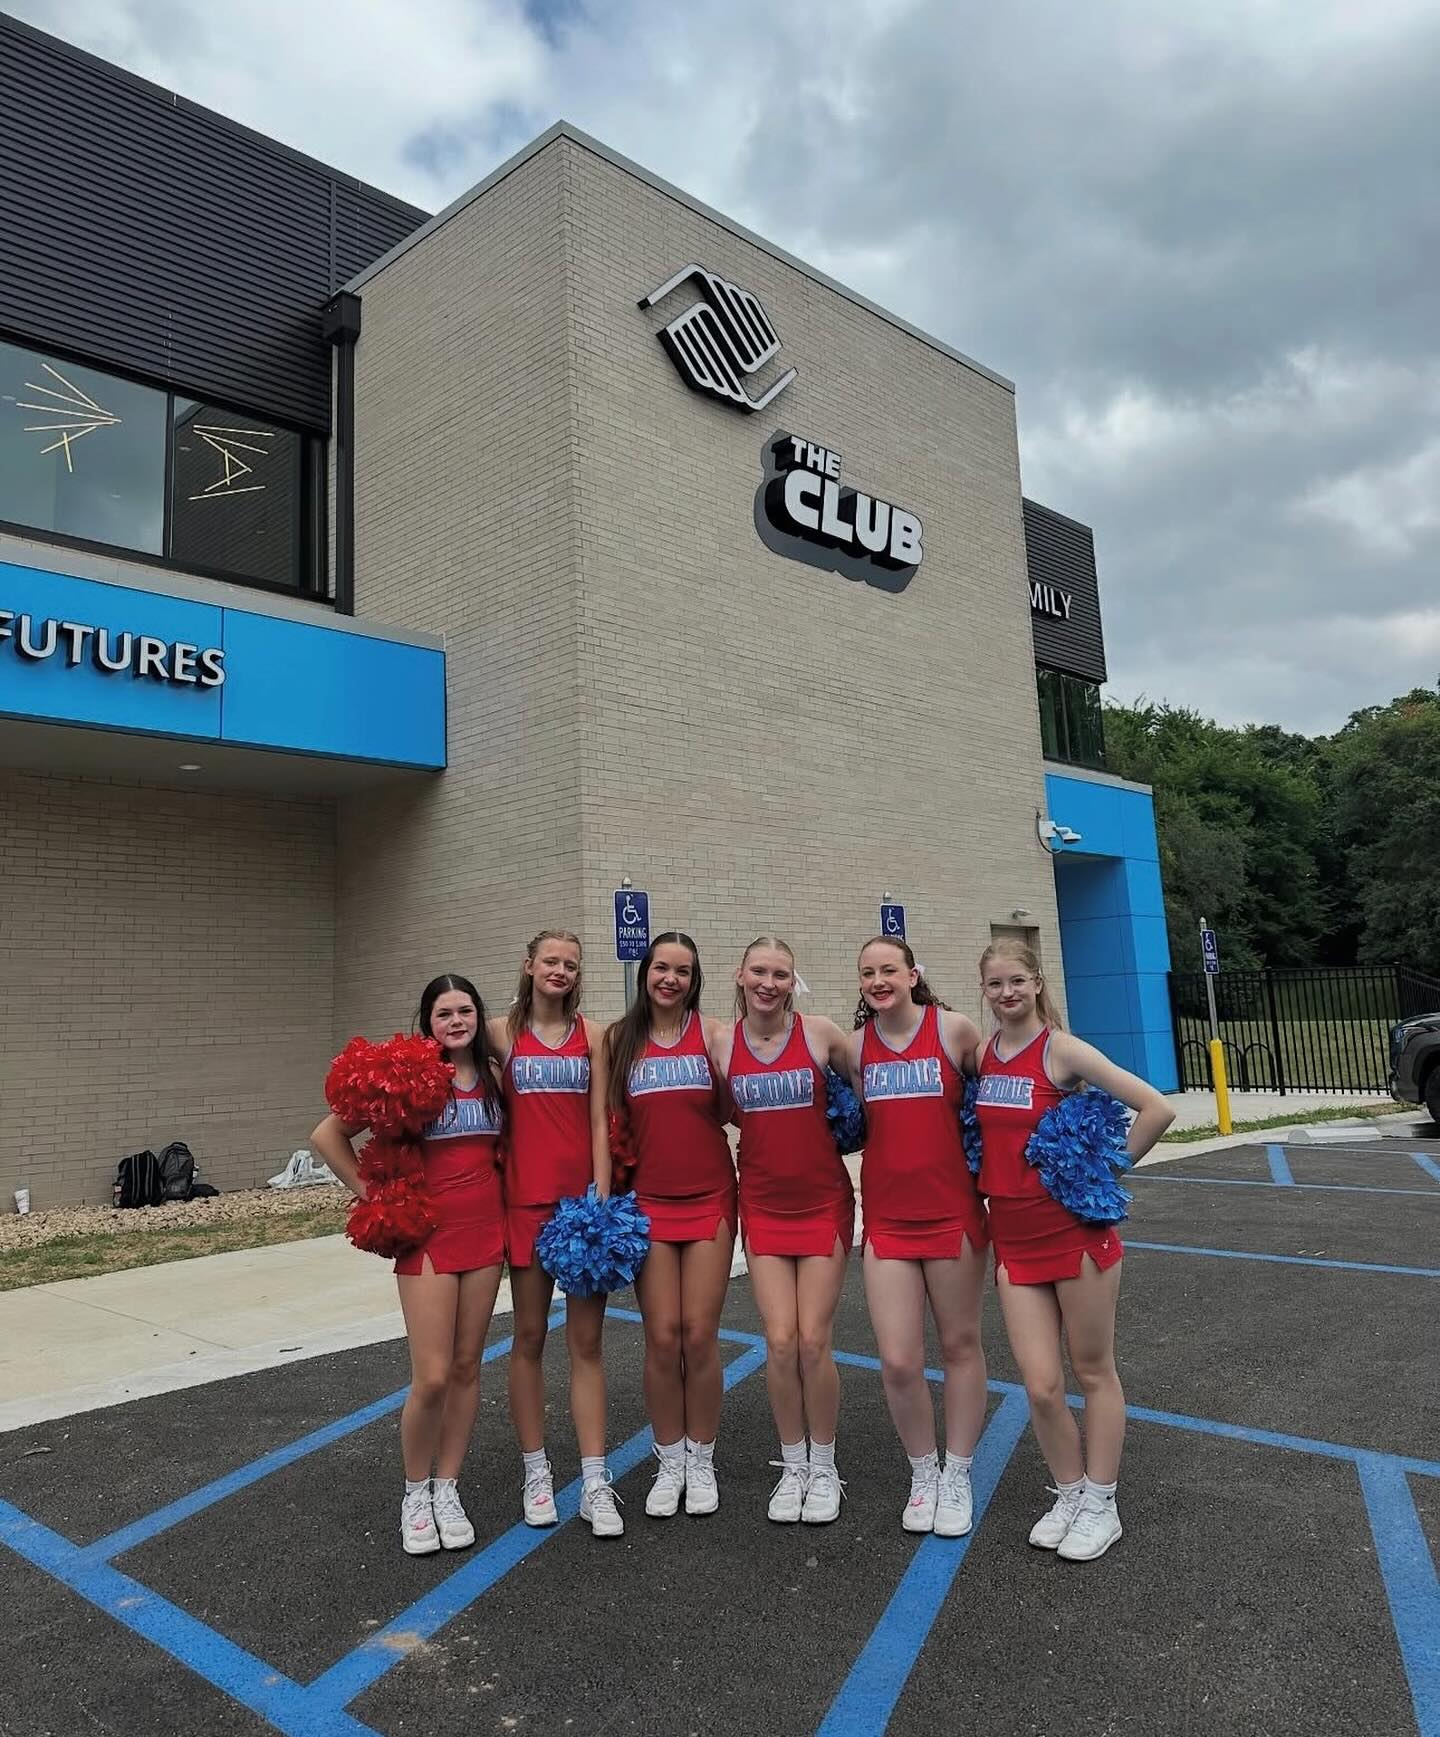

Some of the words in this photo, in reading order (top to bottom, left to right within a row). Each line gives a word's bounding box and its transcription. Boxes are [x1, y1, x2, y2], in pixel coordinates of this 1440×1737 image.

[791, 436, 842, 479] THE
[784, 468, 924, 566] CLUB
[618, 927, 647, 939] PARKING
[731, 1068, 814, 1112] GLENDALE
[864, 1057, 944, 1102] GLENDALE
